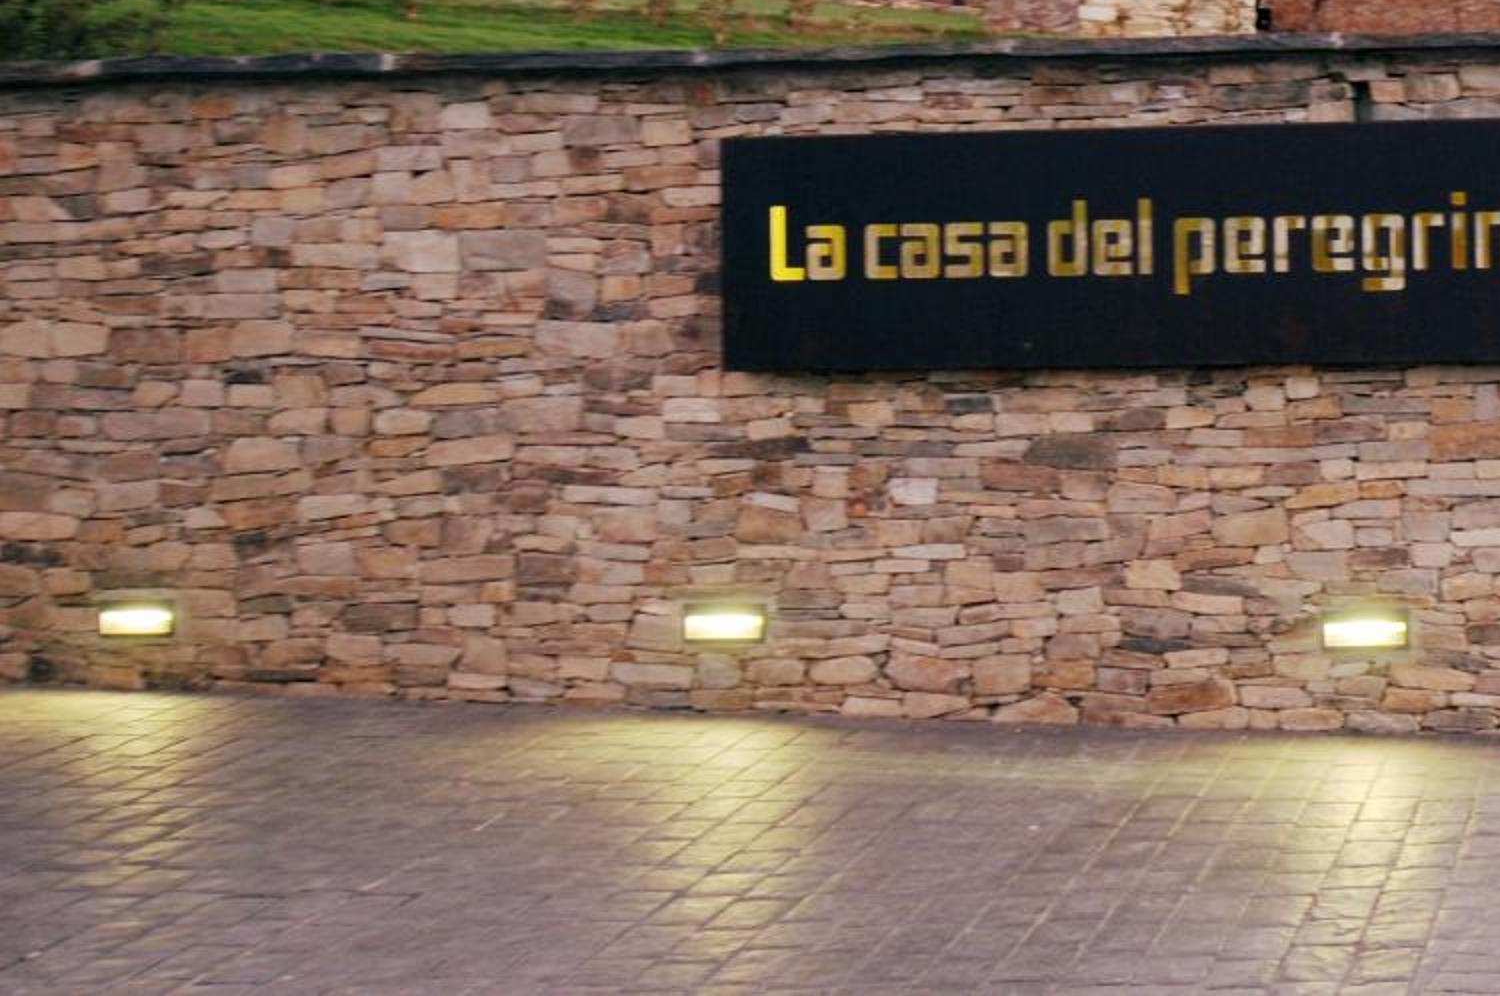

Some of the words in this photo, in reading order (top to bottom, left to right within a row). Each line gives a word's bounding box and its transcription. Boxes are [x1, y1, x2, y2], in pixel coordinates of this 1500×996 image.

[768, 205, 846, 282] La
[864, 221, 1029, 279] casa
[1047, 198, 1153, 276] del
